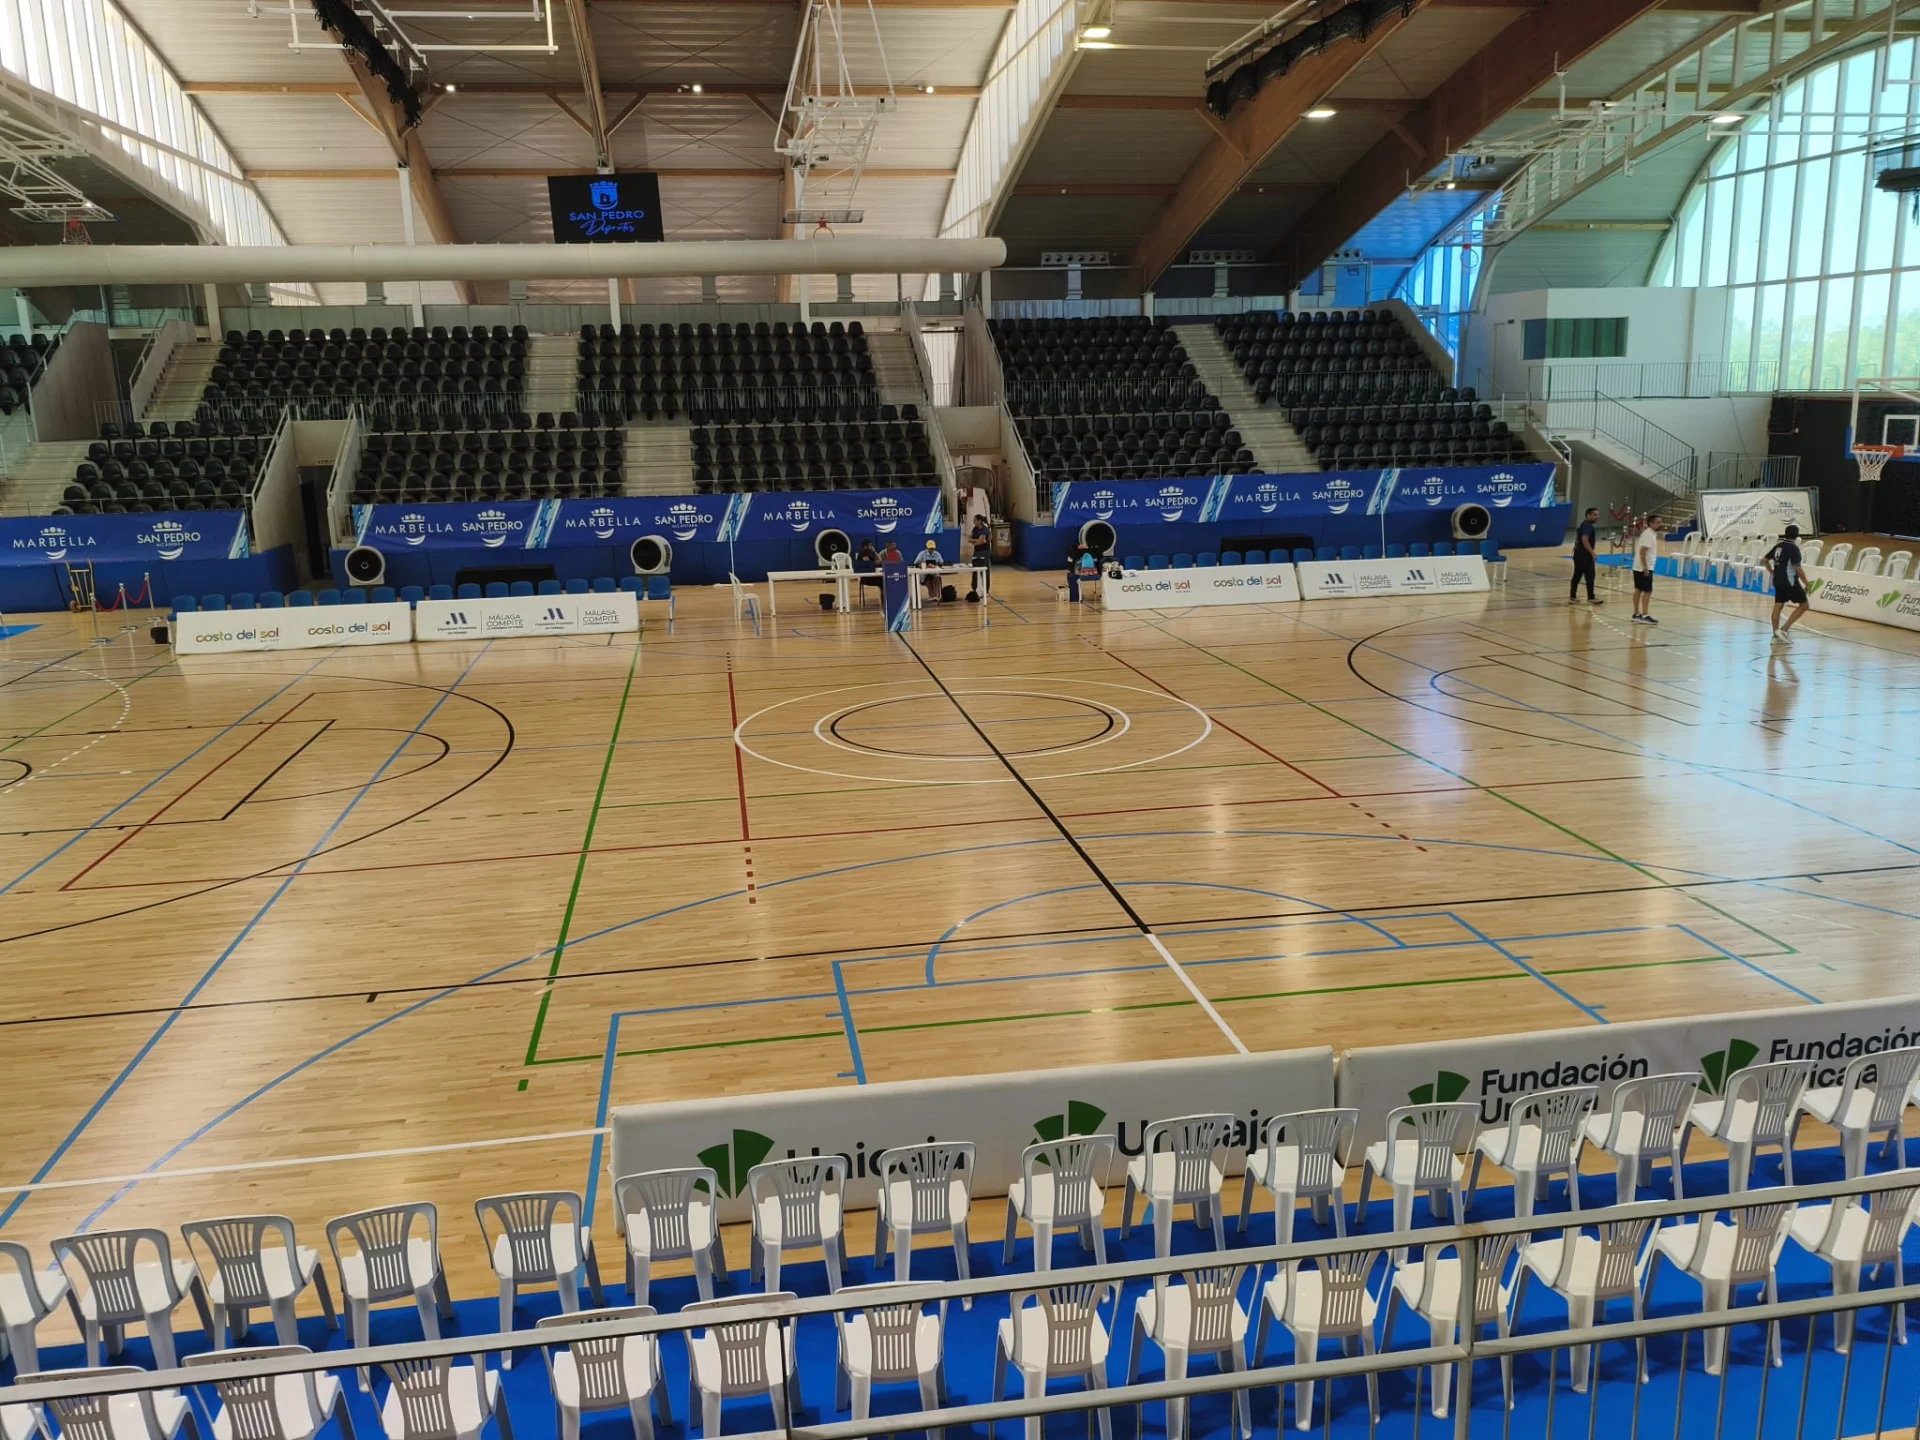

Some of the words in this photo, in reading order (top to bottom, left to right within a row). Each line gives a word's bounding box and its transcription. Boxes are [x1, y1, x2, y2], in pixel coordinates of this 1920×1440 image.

[569, 212, 597, 221] SAN
[601, 210, 645, 220] PEDRO
[1401, 485, 1465, 496] MARBELLA
[1477, 484, 1495, 493] SAN
[1497, 482, 1527, 492] PEDRO
[1234, 492, 1300, 503] MARBELLA
[1312, 491, 1331, 500] SAN
[1333, 489, 1364, 499] PEDRO
[1069, 498, 1138, 510] MARBELLA
[1145, 498, 1164, 507] SAN
[1167, 496, 1198, 506] PEDRO
[763, 510, 836, 521] MARBELLA
[857, 509, 878, 518] SAN
[880, 507, 913, 517] PEDRO
[565, 517, 642, 528] MARBELLA
[654, 516, 677, 525] SAN
[679, 514, 713, 524] PEDRO
[375, 523, 454, 535] MARBELLA
[462, 522, 484, 532] SAN
[487, 520, 523, 531] PEDRO
[12, 536, 97, 549] MARBELLA
[136, 534, 161, 544] SAN
[163, 532, 201, 543] PEDRO
[1121, 582, 1153, 593] costa
[1155, 580, 1172, 591] del
[1174, 579, 1191, 590] sol
[1213, 576, 1244, 588] costa
[1246, 576, 1263, 586] del
[1265, 574, 1282, 585] sol
[1824, 581, 1870, 596] Fundación
[1820, 591, 1852, 605] Unicaja
[486, 619, 524, 627] COMPITE
[582, 615, 620, 623] COMPITE
[307, 624, 344, 636] costa
[348, 622, 368, 633] del
[371, 621, 391, 632] sol
[195, 631, 233, 643] costa
[236, 629, 256, 640] del
[260, 627, 279, 638] sol
[1481, 1053, 1649, 1096] Fundación
